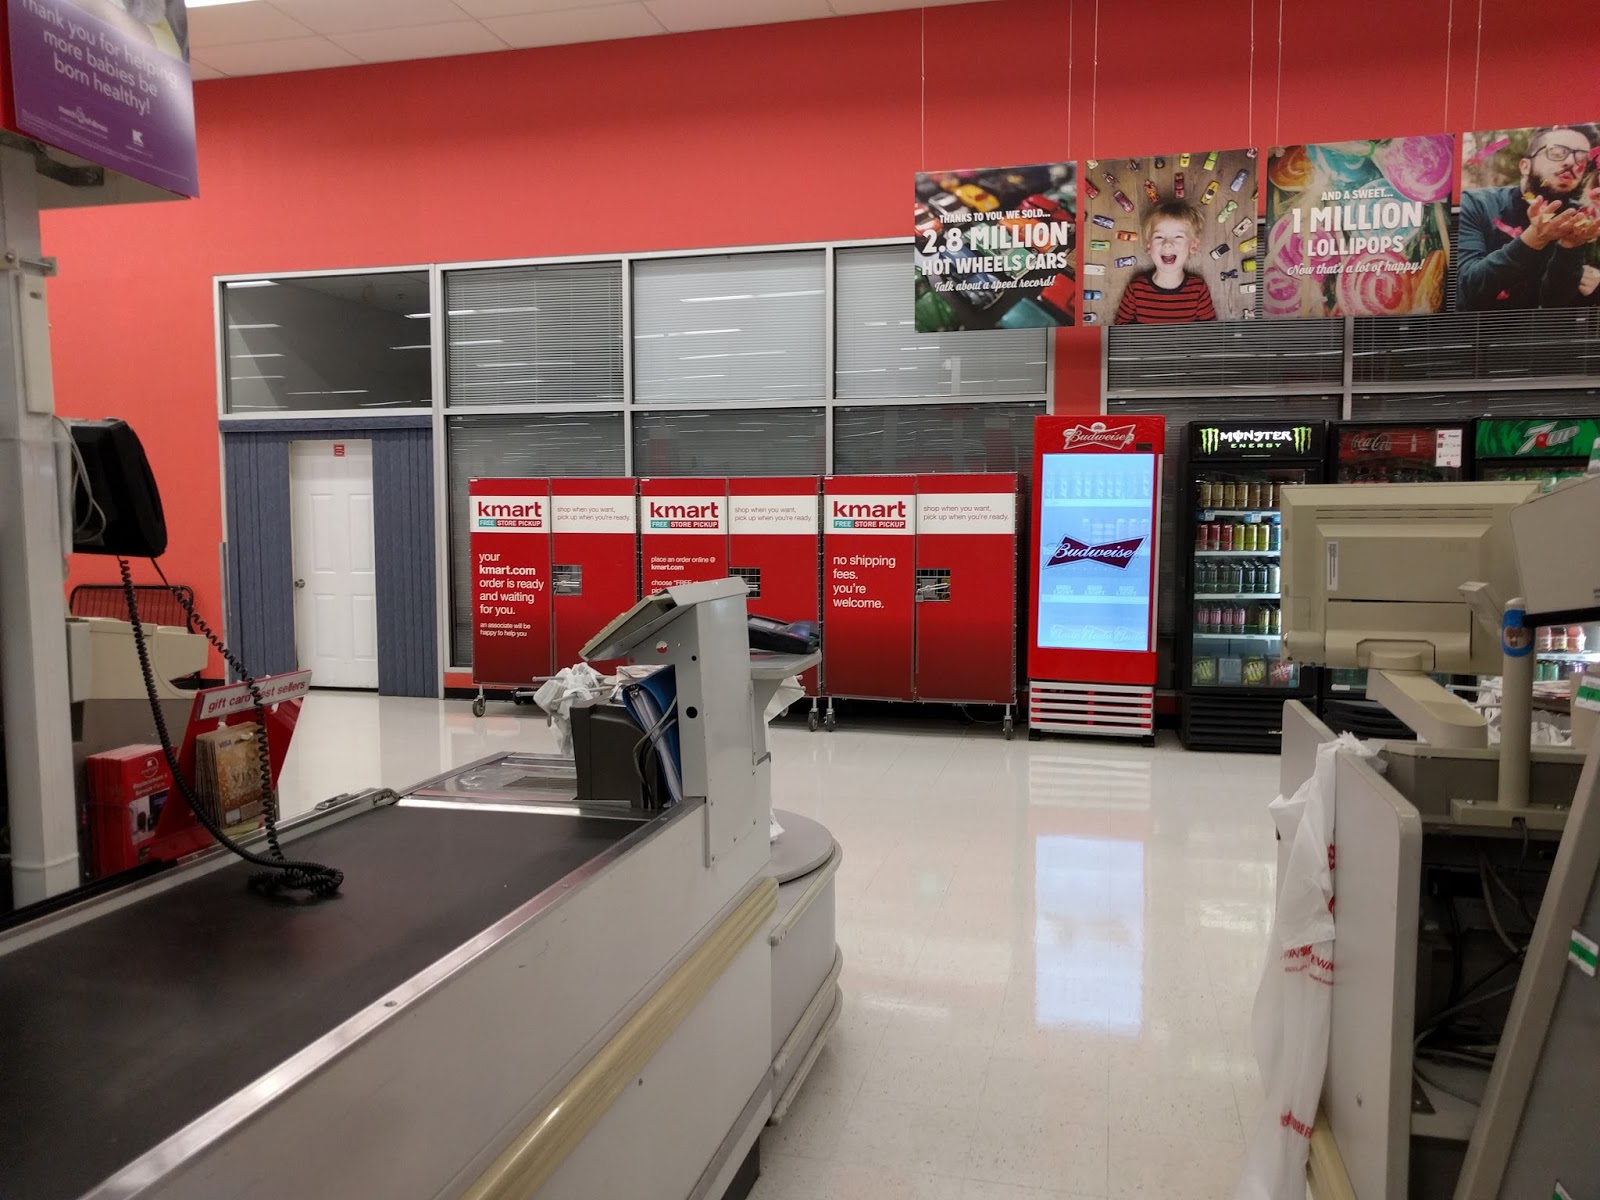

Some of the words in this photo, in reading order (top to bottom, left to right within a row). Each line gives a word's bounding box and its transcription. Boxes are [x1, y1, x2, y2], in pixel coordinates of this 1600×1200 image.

[67, 20, 96, 46] you
[99, 32, 119, 57] for
[124, 45, 178, 89] helping
[43, 30, 83, 61] more
[86, 46, 136, 87] babies
[138, 72, 158, 97] be
[53, 52, 90, 86] born
[93, 72, 151, 116] healthy!
[1321, 191, 1341, 201] AND
[1343, 191, 1351, 200] A
[1352, 188, 1393, 199] SWEET...
[939, 212, 972, 224] THANKS
[973, 212, 984, 222] TO
[986, 211, 1004, 221] YOU,
[1006, 210, 1020, 219] WE
[1021, 208, 1051, 219] SOLD...
[1292, 208, 1302, 234] 1
[1309, 201, 1422, 233] MILLION
[922, 227, 964, 254] 2.8
[970, 221, 1068, 251] MILLION
[1307, 235, 1404, 257] LOLLIPOPS
[921, 258, 952, 276] HOT
[956, 254, 1022, 274] WHEELS
[1025, 252, 1067, 270] CARS
[1287, 263, 1314, 276] Now
[1316, 262, 1343, 275] that's
[1354, 262, 1369, 273] lot
[1371, 261, 1383, 276] of
[1384, 259, 1424, 274] happy!
[934, 281, 954, 292] Talk
[956, 279, 982, 291] about
[990, 279, 1018, 292] speed
[1019, 275, 1056, 289] record!
[1063, 428, 1135, 445] Budweiser
[1220, 430, 1292, 442] MONSTER
[478, 501, 542, 517] kmart
[650, 502, 719, 518] kmart
[834, 501, 906, 517] kmart
[479, 553, 500, 563] your
[1054, 543, 1138, 559] Budweise
[479, 564, 536, 575] kmart.com
[833, 557, 847, 565] no
[850, 555, 896, 568] shipping
[833, 568, 858, 579] fees.
[479, 578, 505, 588] order
[506, 578, 515, 588] is
[517, 579, 544, 591] ready
[833, 583, 866, 595] you're
[480, 591, 498, 601] and
[500, 591, 535, 604] waiting
[833, 597, 884, 608] welcome.
[479, 604, 493, 614] for
[495, 606, 516, 616] you.
[208, 695, 226, 713] gift
[255, 687, 275, 699] est
[277, 681, 306, 694] sellers
